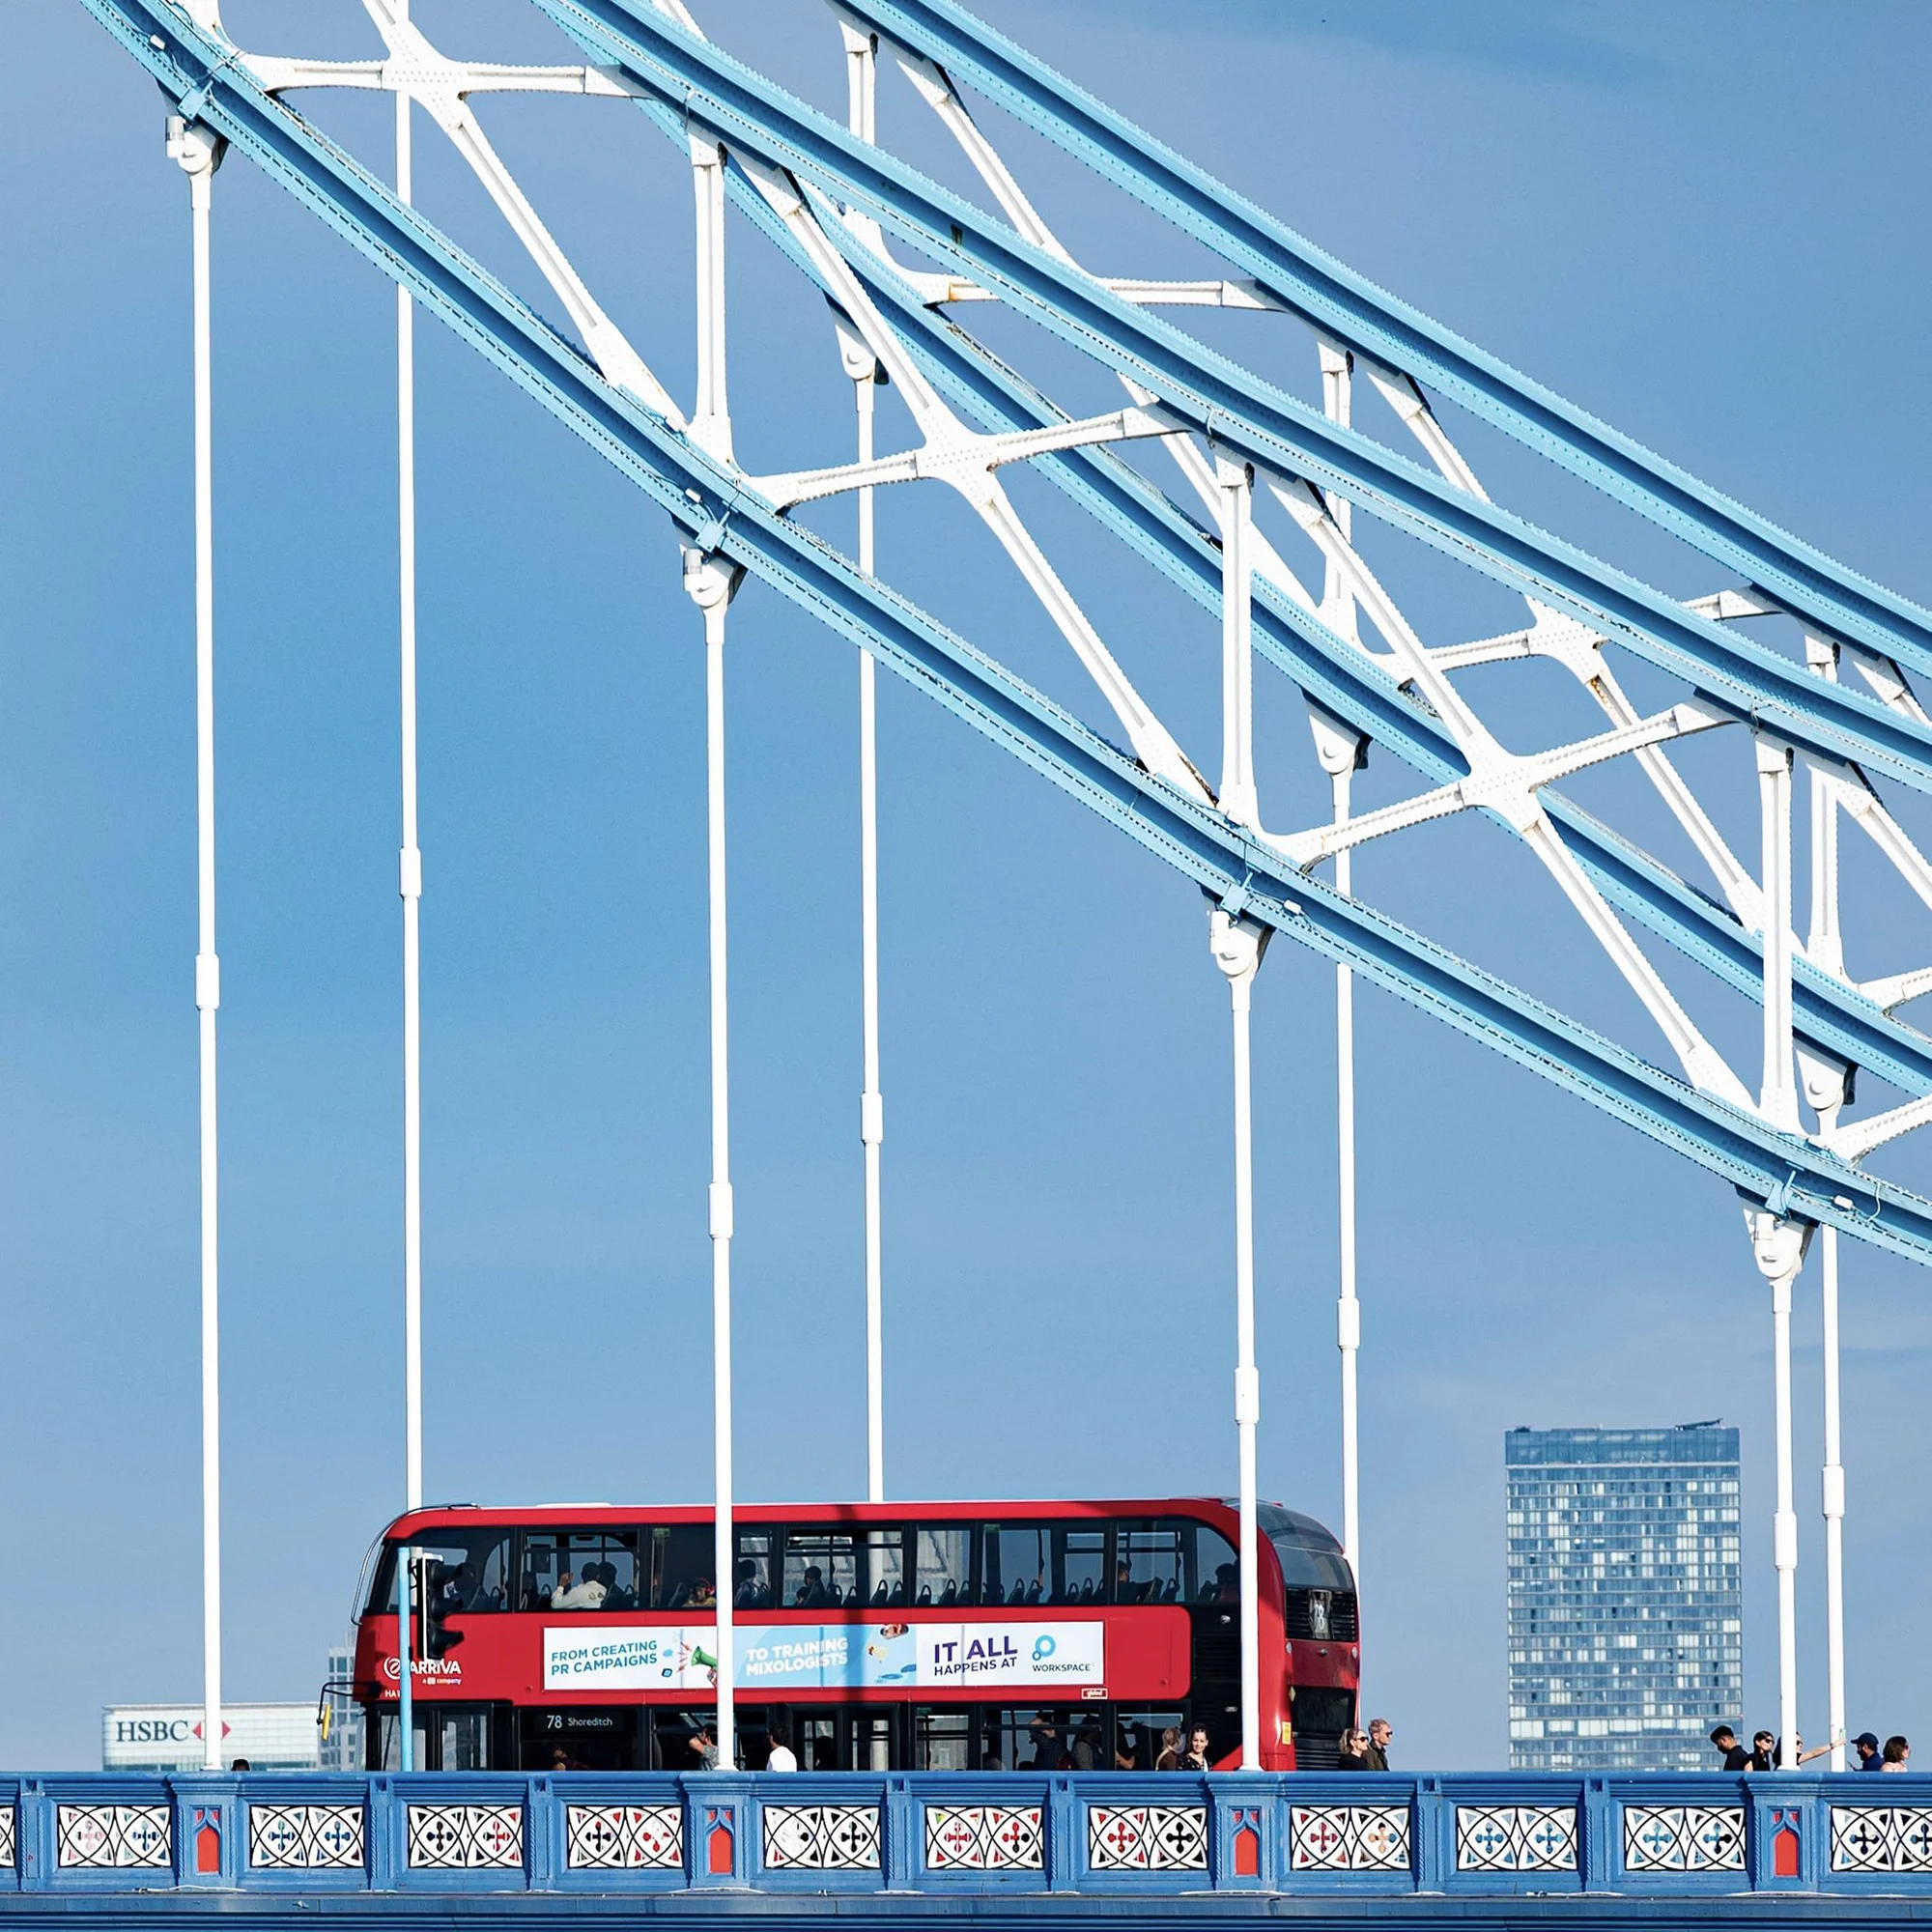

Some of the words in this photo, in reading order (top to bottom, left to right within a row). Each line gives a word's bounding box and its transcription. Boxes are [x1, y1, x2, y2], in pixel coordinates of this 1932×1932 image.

[552, 1649, 587, 1662] FROM
[592, 1640, 657, 1658] CREATING
[746, 1648, 769, 1662] TO
[772, 1637, 848, 1659] TRAINING
[934, 1641, 958, 1663] IT
[966, 1635, 1018, 1660] ALL
[410, 1660, 462, 1675] ARRIVA
[551, 1663, 569, 1676] PR
[574, 1653, 658, 1673] CAMPAIGNS
[746, 1652, 848, 1676] MIXOLOGISTS
[934, 1660, 997, 1676] HAPPENS
[1001, 1657, 1017, 1668] AT
[1032, 1663, 1091, 1672] WORKSPACE
[116, 1719, 188, 1742] HSBC
[546, 1715, 562, 1729] 78
[567, 1717, 613, 1727] Shoreditch
